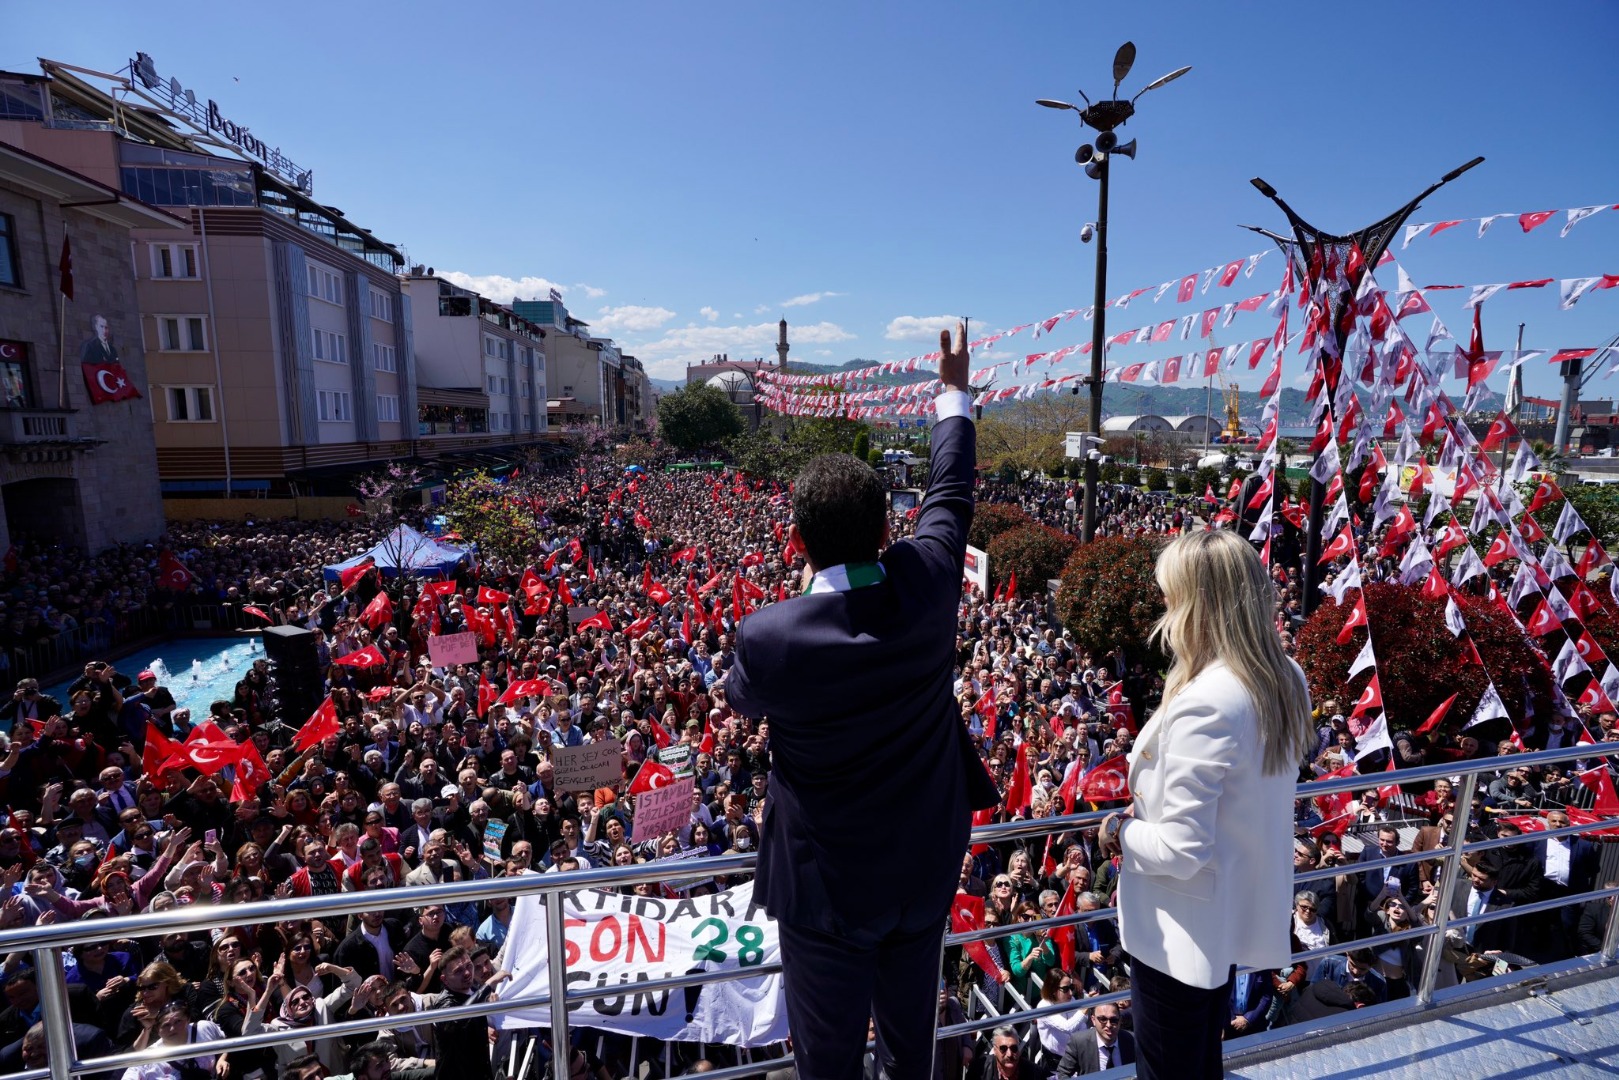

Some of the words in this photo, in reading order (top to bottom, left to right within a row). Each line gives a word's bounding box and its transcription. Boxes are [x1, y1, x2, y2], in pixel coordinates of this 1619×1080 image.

[556, 754, 578, 767] HER
[563, 914, 667, 966] SON
[691, 917, 765, 967] 28
